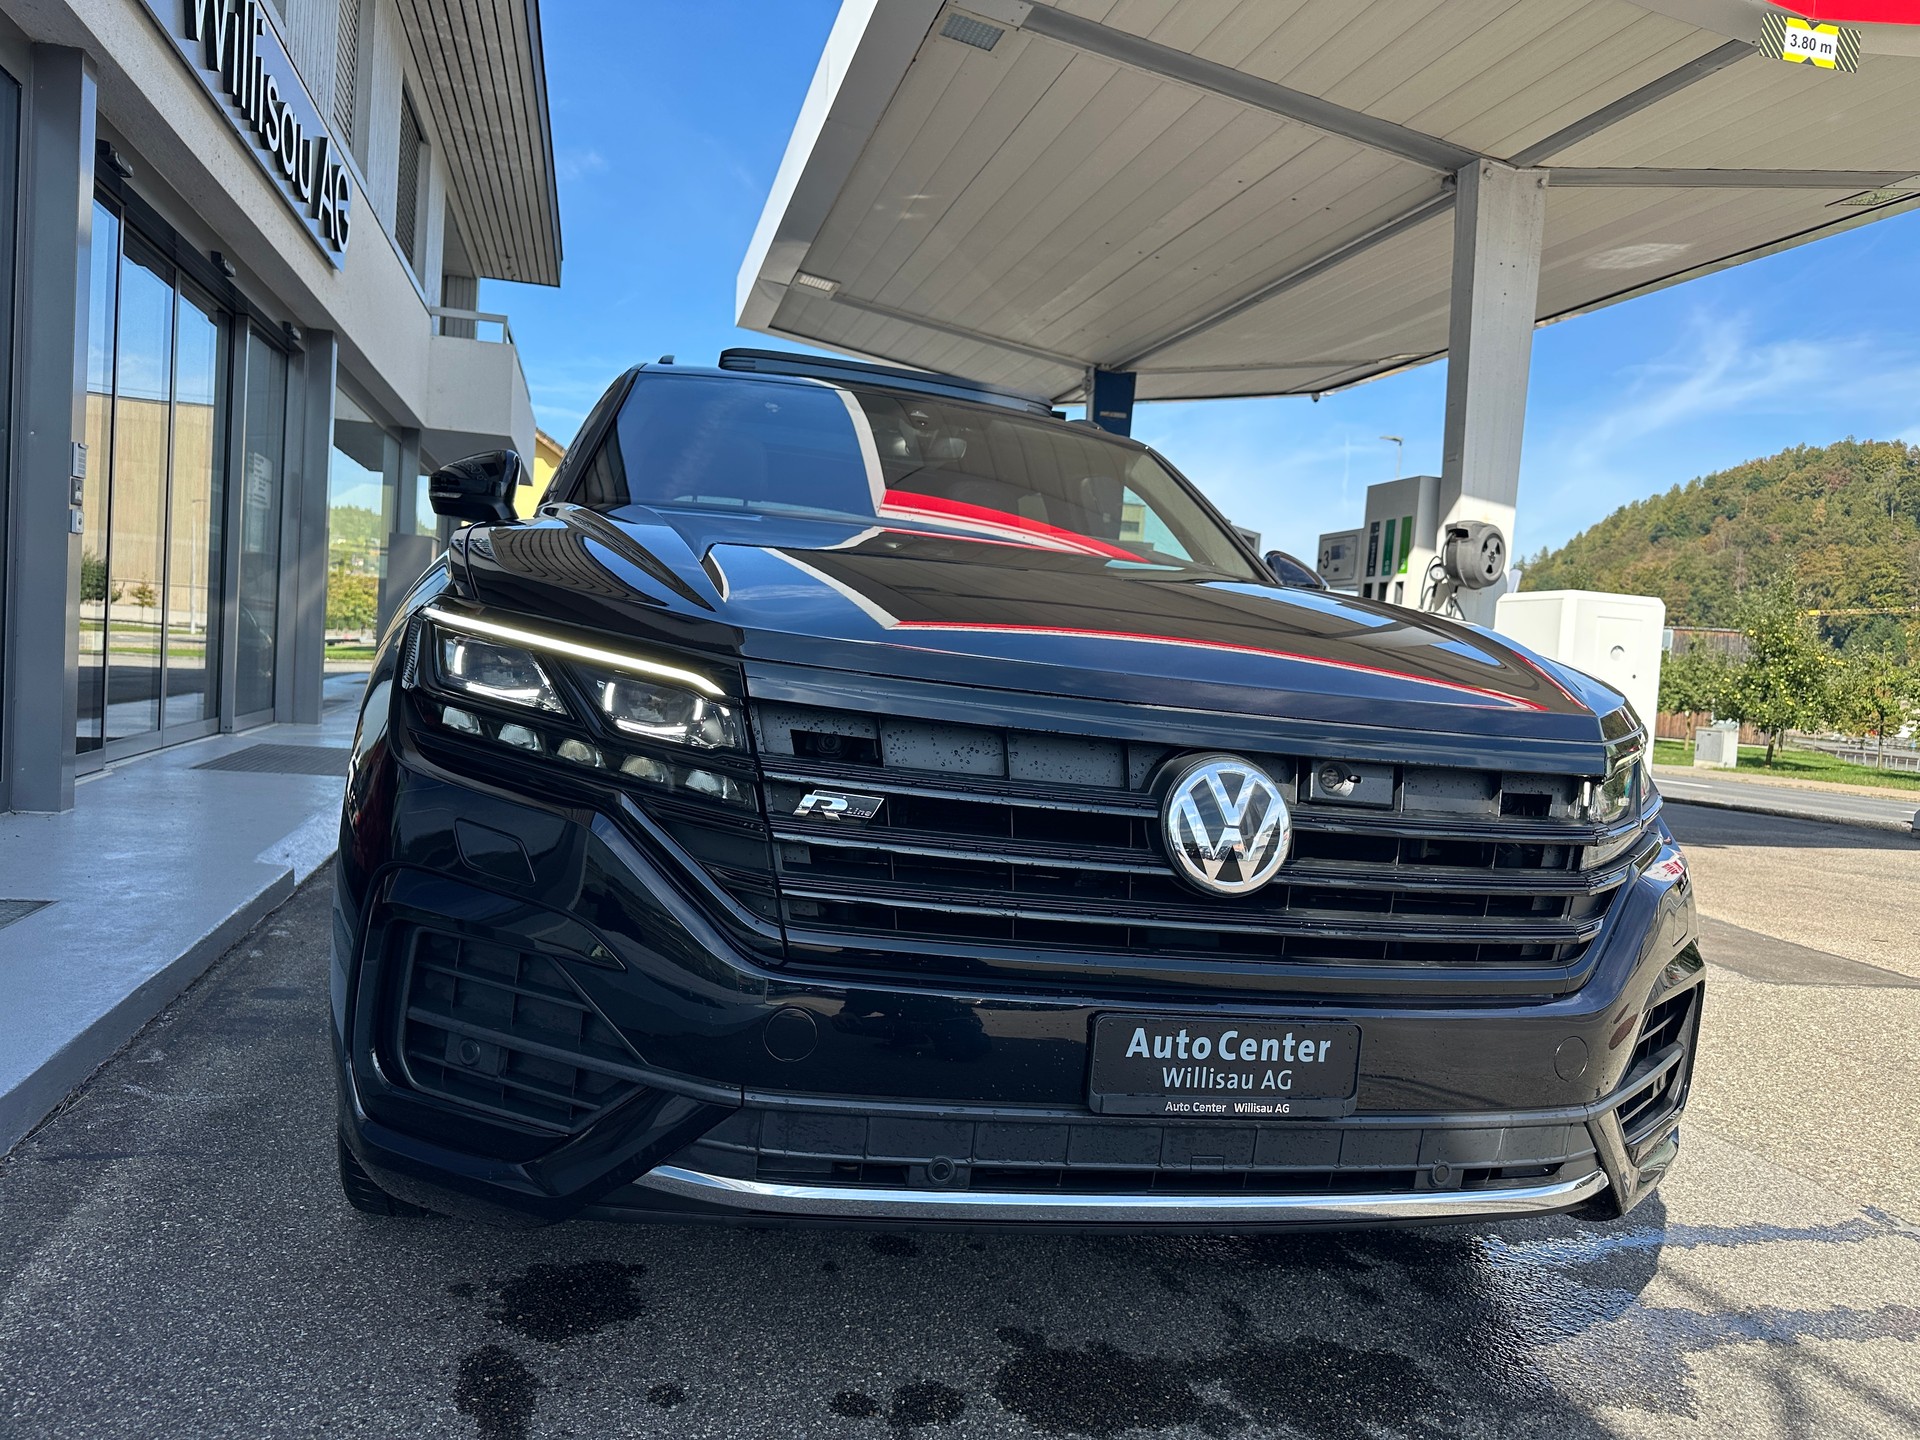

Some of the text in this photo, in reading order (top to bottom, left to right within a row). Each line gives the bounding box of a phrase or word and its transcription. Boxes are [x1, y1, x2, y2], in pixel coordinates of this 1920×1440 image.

[1790, 34, 1832, 54] 3.80 m
[314, 137, 350, 253] AG
[1323, 550, 1330, 569] 3
[1125, 1028, 1331, 1063] Auto Center
[1162, 1066, 1293, 1090] Willisau AG
[1165, 1101, 1291, 1114] Auto Center Willisau AG
